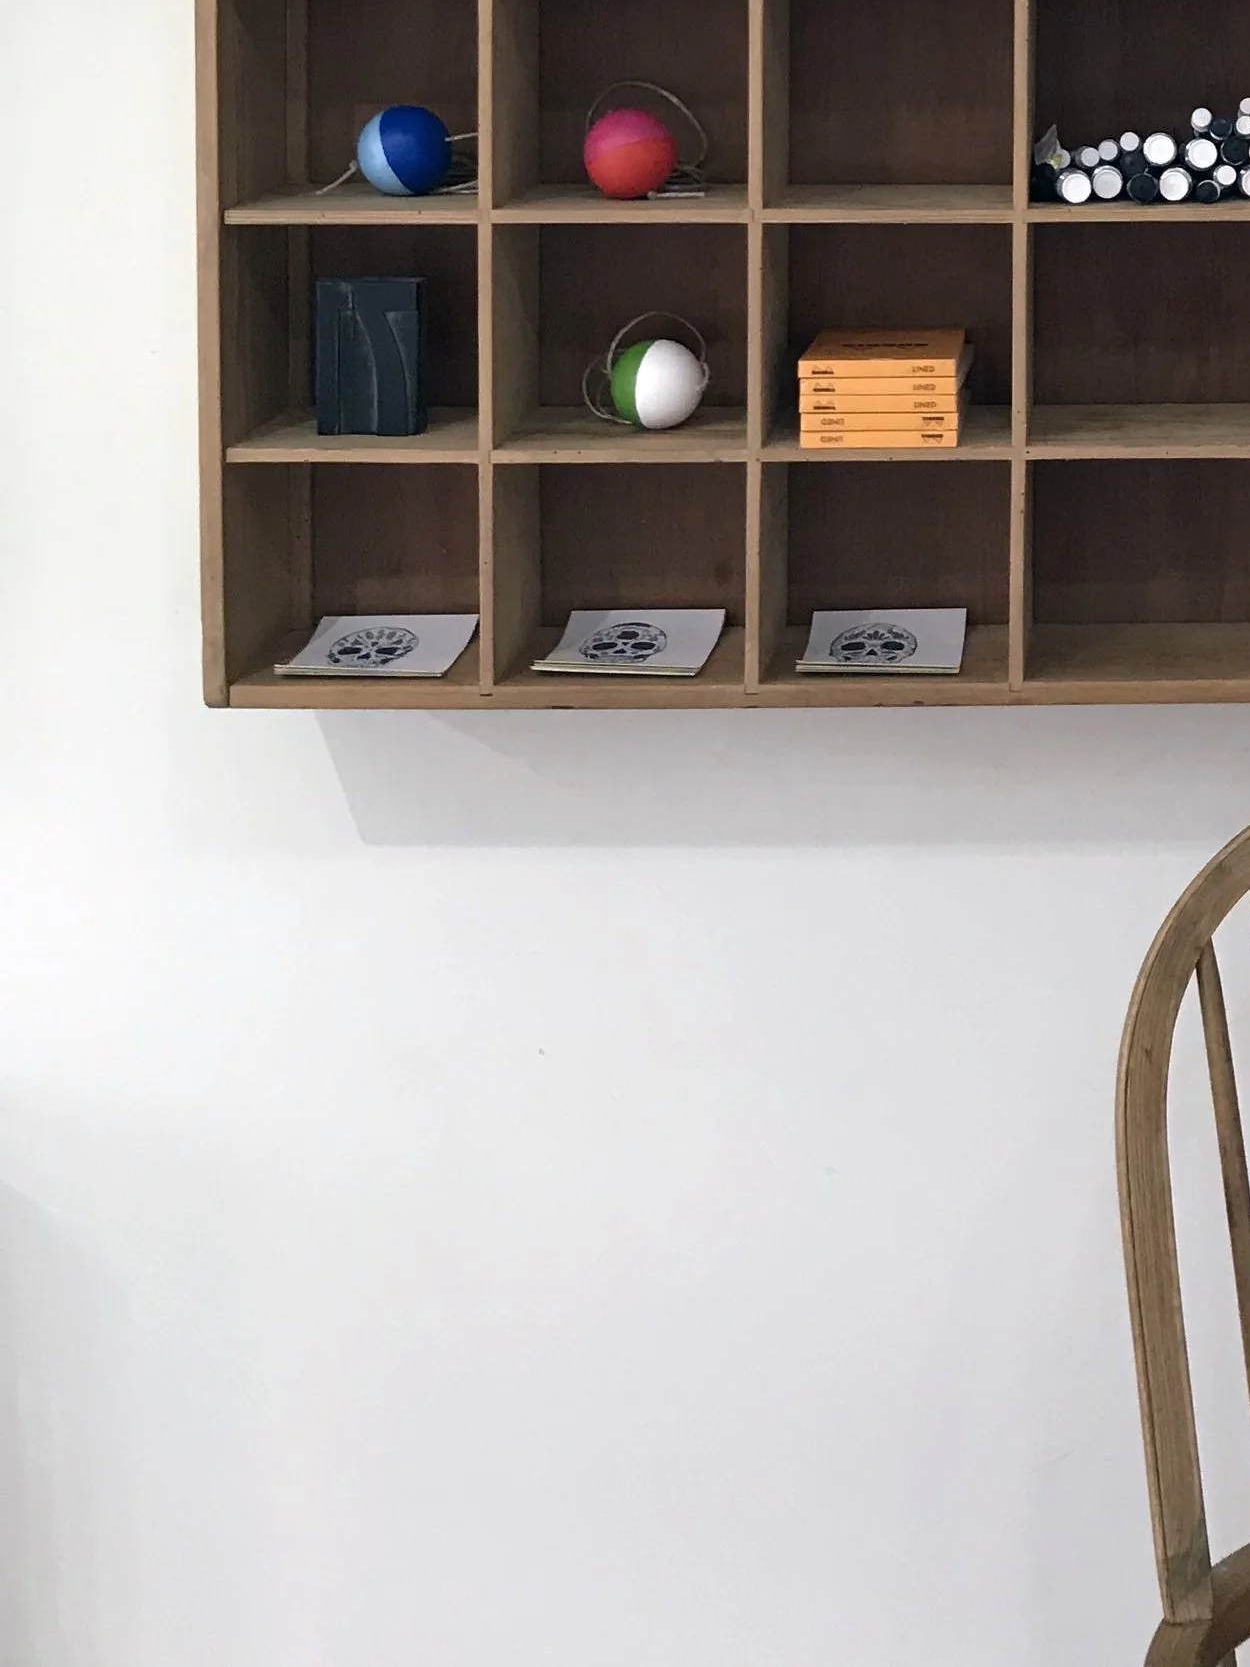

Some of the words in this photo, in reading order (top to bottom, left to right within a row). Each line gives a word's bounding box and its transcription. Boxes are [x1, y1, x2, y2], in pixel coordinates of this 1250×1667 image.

[912, 366, 935, 374] LINED
[913, 383, 936, 391] LINED
[914, 401, 937, 409] LINED
